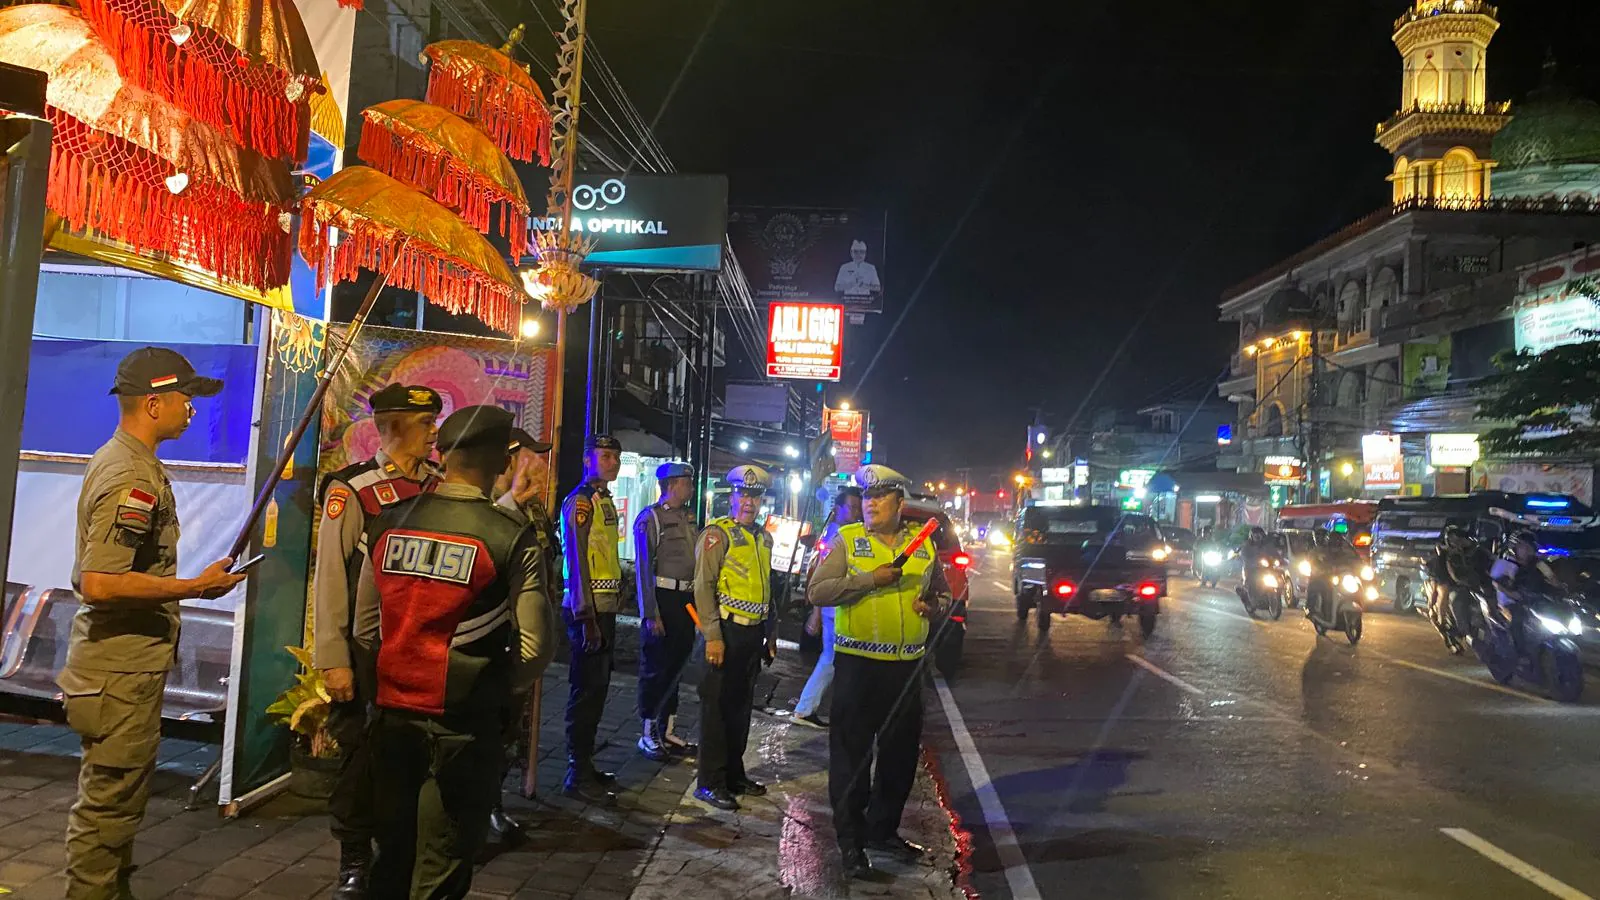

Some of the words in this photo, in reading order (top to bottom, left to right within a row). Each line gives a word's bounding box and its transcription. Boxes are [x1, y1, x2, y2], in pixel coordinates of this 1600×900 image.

[587, 218, 669, 235] OPTIKAL
[808, 306, 841, 346] GIGI
[385, 537, 473, 580] POLISI
